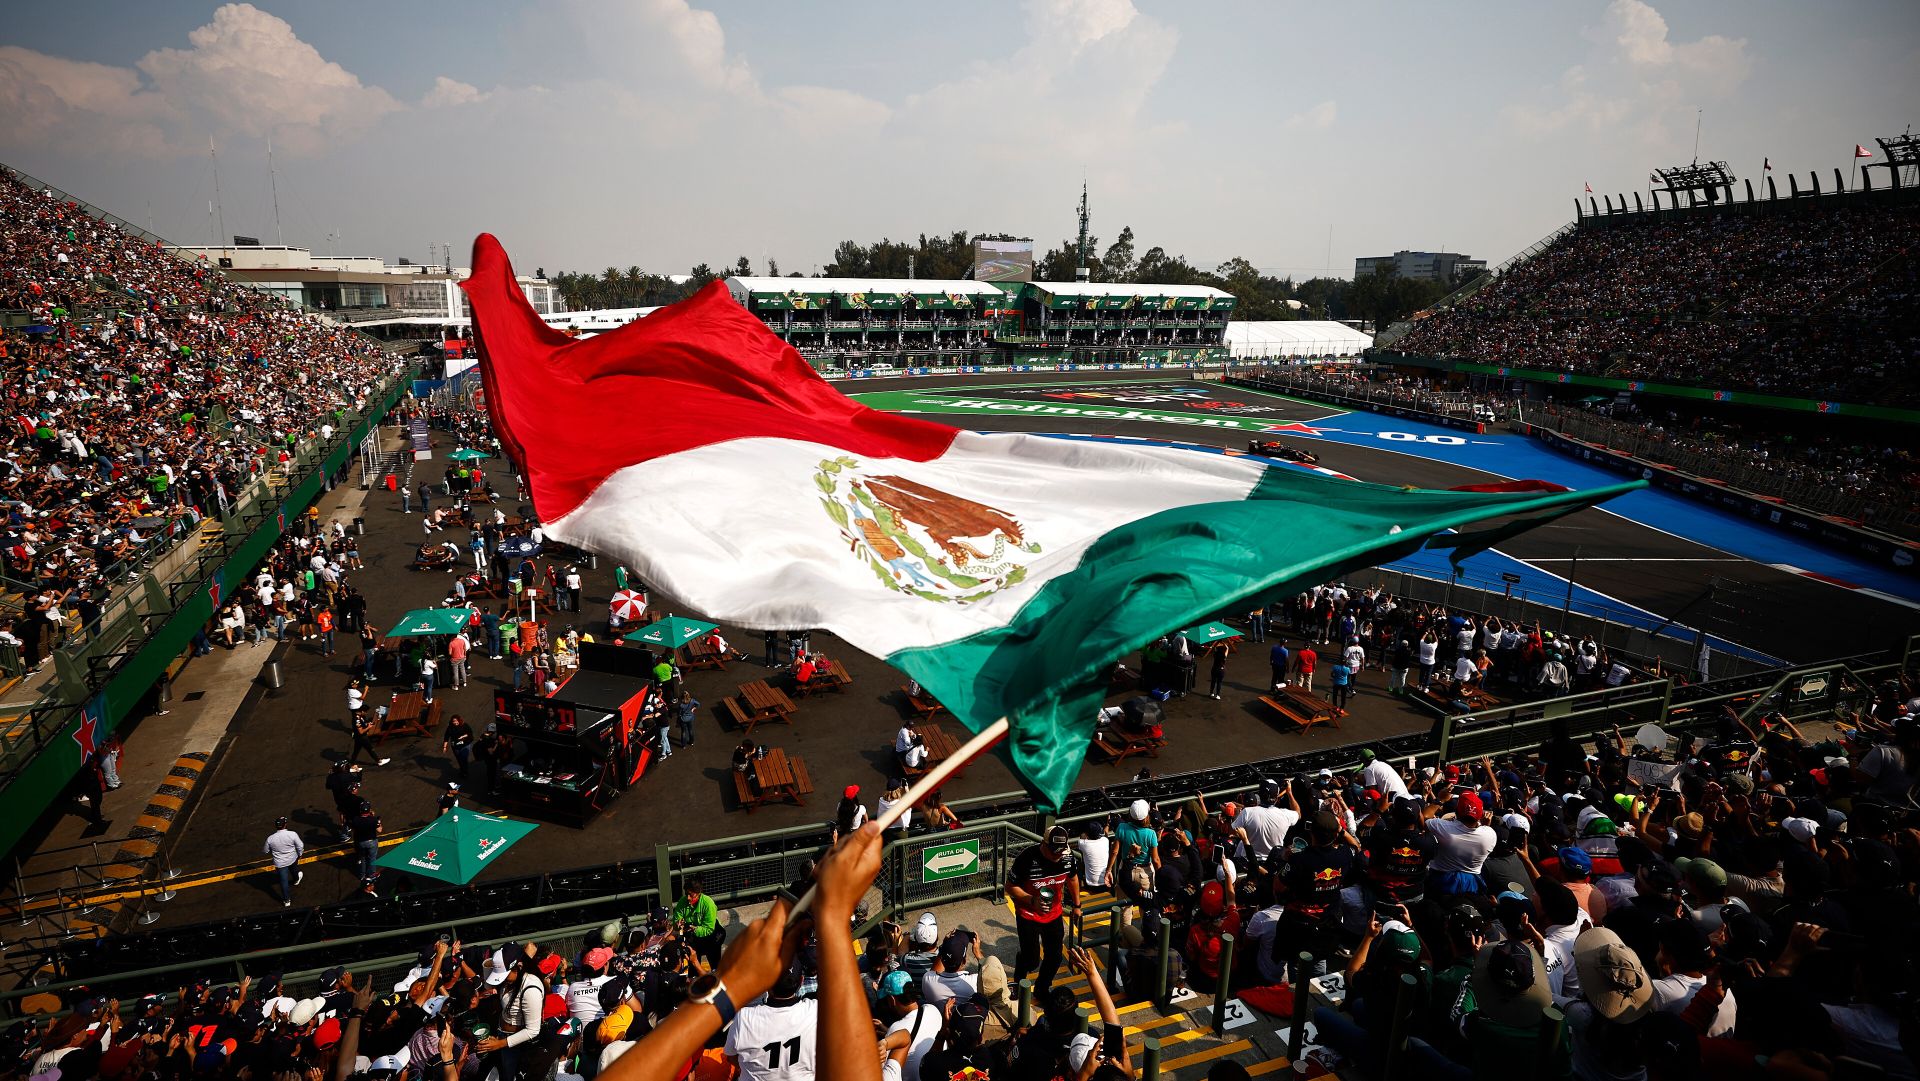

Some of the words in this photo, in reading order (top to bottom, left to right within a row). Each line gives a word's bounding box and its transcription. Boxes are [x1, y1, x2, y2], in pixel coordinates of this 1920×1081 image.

[817, 371, 845, 379] eineken
[941, 399, 1244, 428] Heineken
[1376, 431, 1468, 446] 0.0
[476, 836, 508, 861] Heineken
[408, 857, 442, 872] Heineken
[573, 986, 602, 996] PETRON
[762, 1035, 801, 1069] 11
